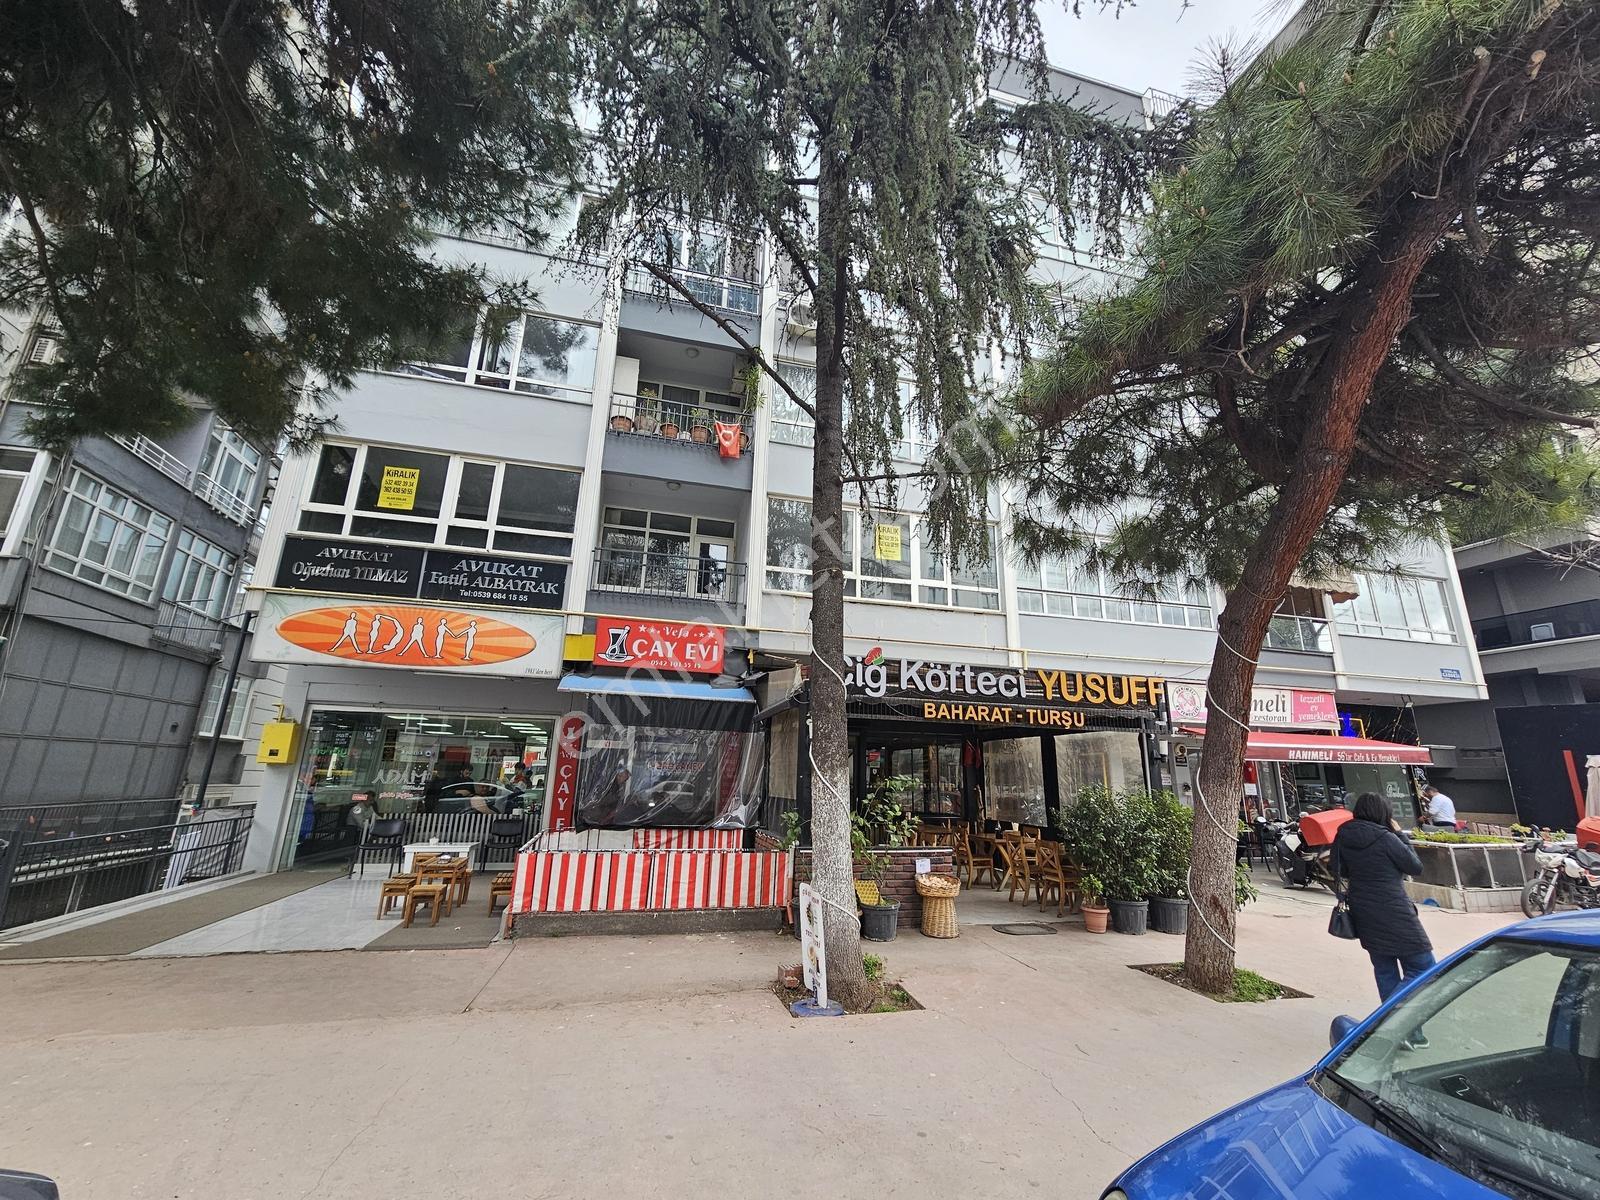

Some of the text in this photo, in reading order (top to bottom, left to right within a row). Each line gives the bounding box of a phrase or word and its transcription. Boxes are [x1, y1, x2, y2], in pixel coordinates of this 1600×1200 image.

[315, 547, 393, 563] AVUKAT
[291, 561, 409, 584] Oğuzhan YILMAZ
[452, 559, 543, 579] AVUKAT
[428, 571, 559, 595] Fatih ALBAYRAK
[459, 589, 491, 599] Tel:0539
[493, 592, 507, 601] 684
[518, 594, 528, 602] 55
[326, 611, 479, 662] ADAM
[632, 638, 719, 663] ÇAY EVİ
[900, 658, 1027, 698] Köfteci
[924, 702, 1012, 723] BAHARAT
[1026, 708, 1085, 729] TURŞU
[1289, 750, 1333, 761] HANIMELİ
